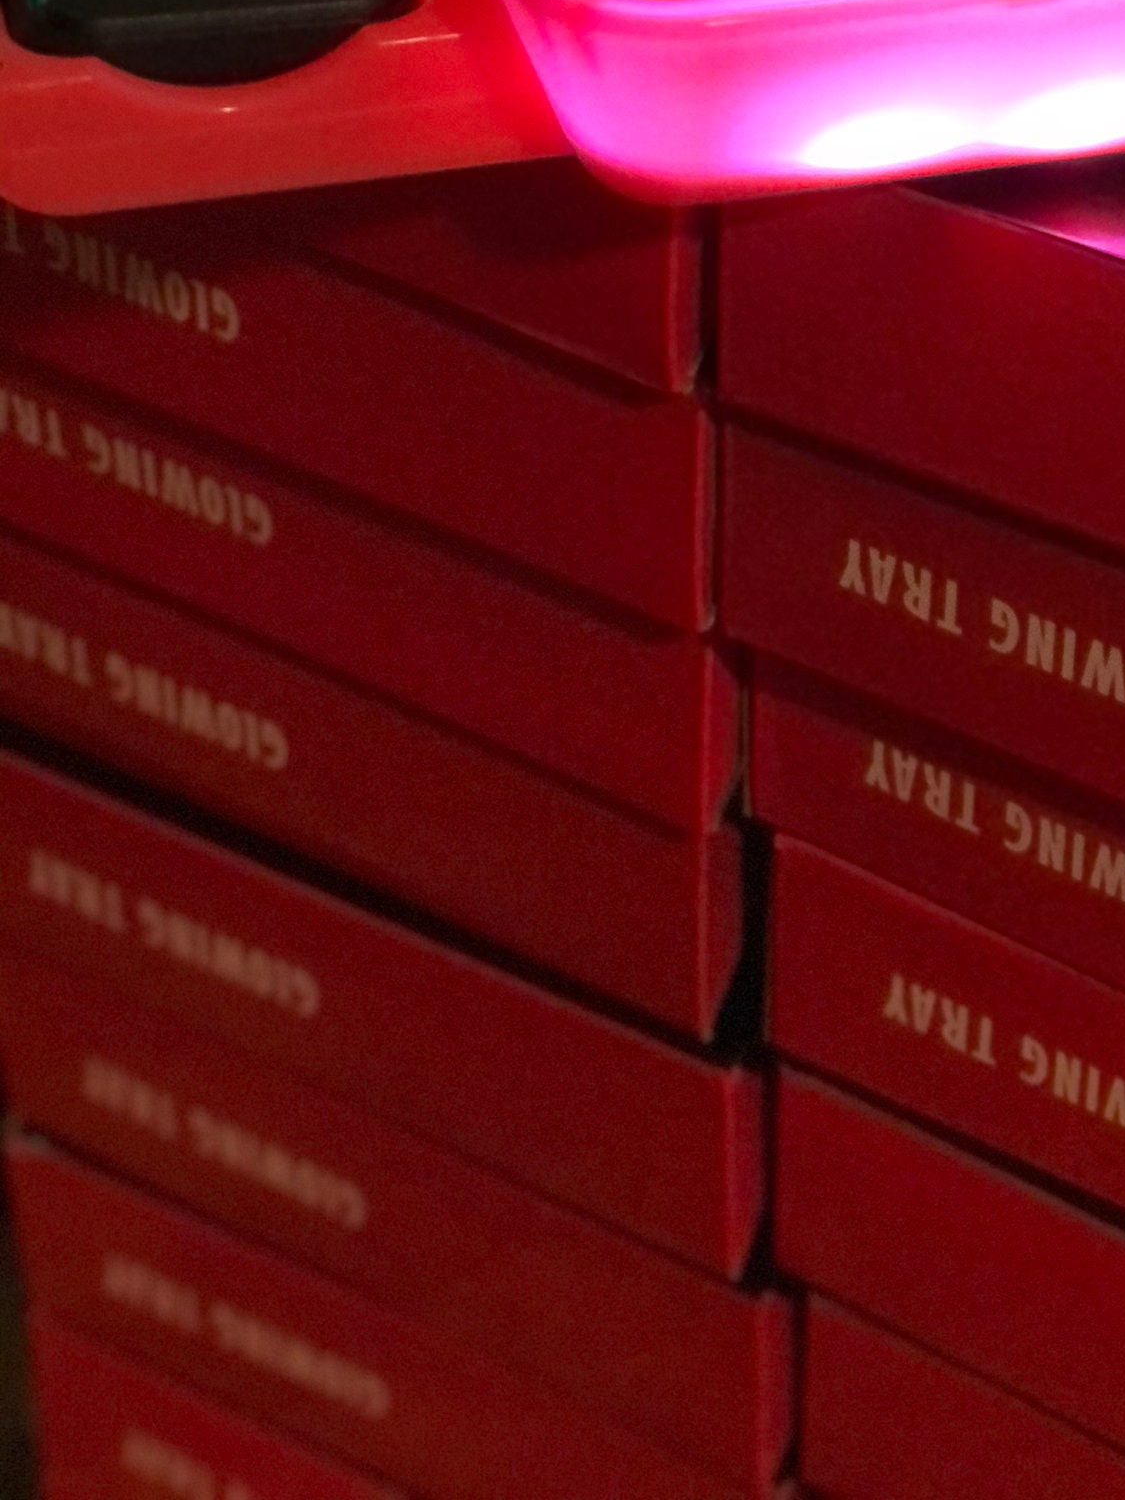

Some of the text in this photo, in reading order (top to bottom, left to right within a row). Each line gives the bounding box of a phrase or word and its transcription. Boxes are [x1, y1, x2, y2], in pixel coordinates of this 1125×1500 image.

[839, 538, 963, 636] TRAY
[865, 739, 981, 836] TRAY
[882, 973, 996, 1067] TRAY
